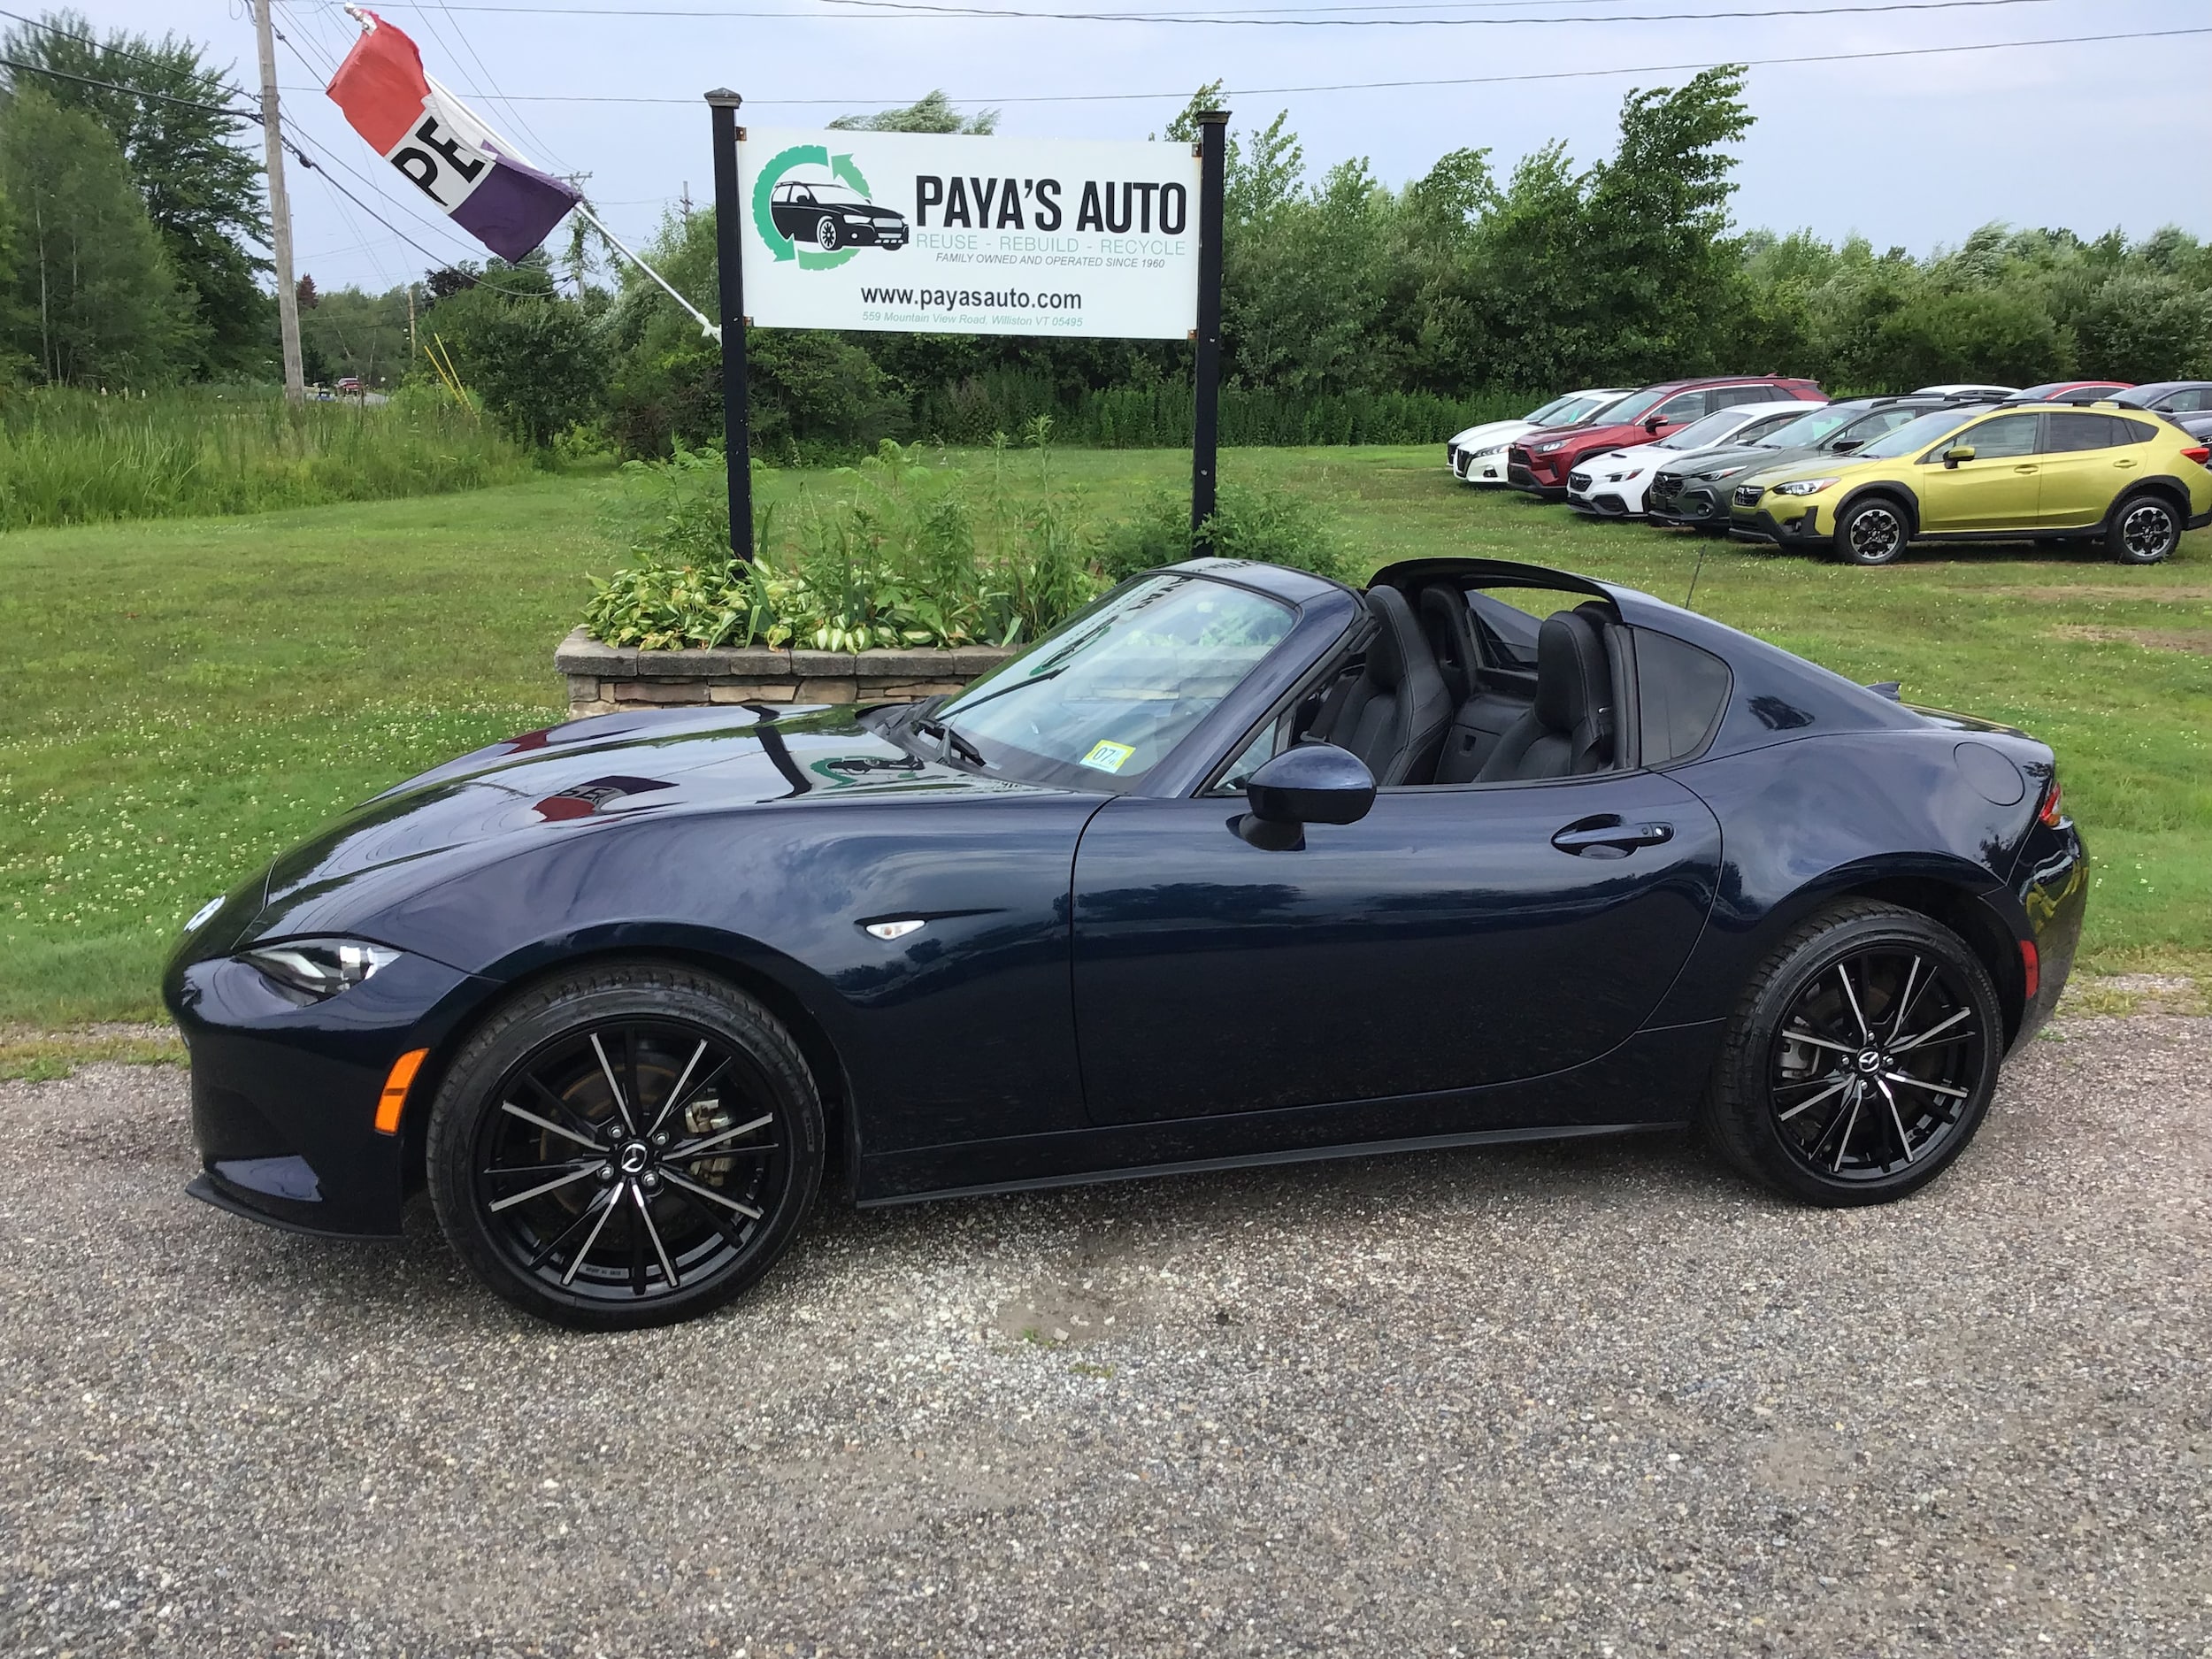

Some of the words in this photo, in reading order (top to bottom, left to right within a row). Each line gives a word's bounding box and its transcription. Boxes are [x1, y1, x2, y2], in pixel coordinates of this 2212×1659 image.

[390, 115, 486, 206] PE
[916, 174, 1062, 232] PAYA'S
[1076, 180, 1187, 235] AUTO
[916, 233, 978, 250] REUSE
[1000, 235, 1079, 253] REBUILD
[1100, 238, 1186, 256] RECYCLE
[935, 252, 974, 263] FAMILY
[976, 253, 1018, 265] OWNED
[1019, 255, 1042, 265] AND
[1045, 256, 1103, 266] OPERATED
[1105, 257, 1139, 267] SINCE
[1141, 258, 1165, 269] 1960
[860, 287, 1082, 311] www.payasauto.com
[862, 311, 881, 321] 559
[883, 311, 930, 323] Mountain
[933, 313, 957, 324] View
[959, 314, 988, 326] Road,
[991, 315, 1033, 326] Williston
[1035, 316, 1050, 326] VT
[1051, 317, 1083, 327] 05495
[1093, 747, 1117, 762] 07
